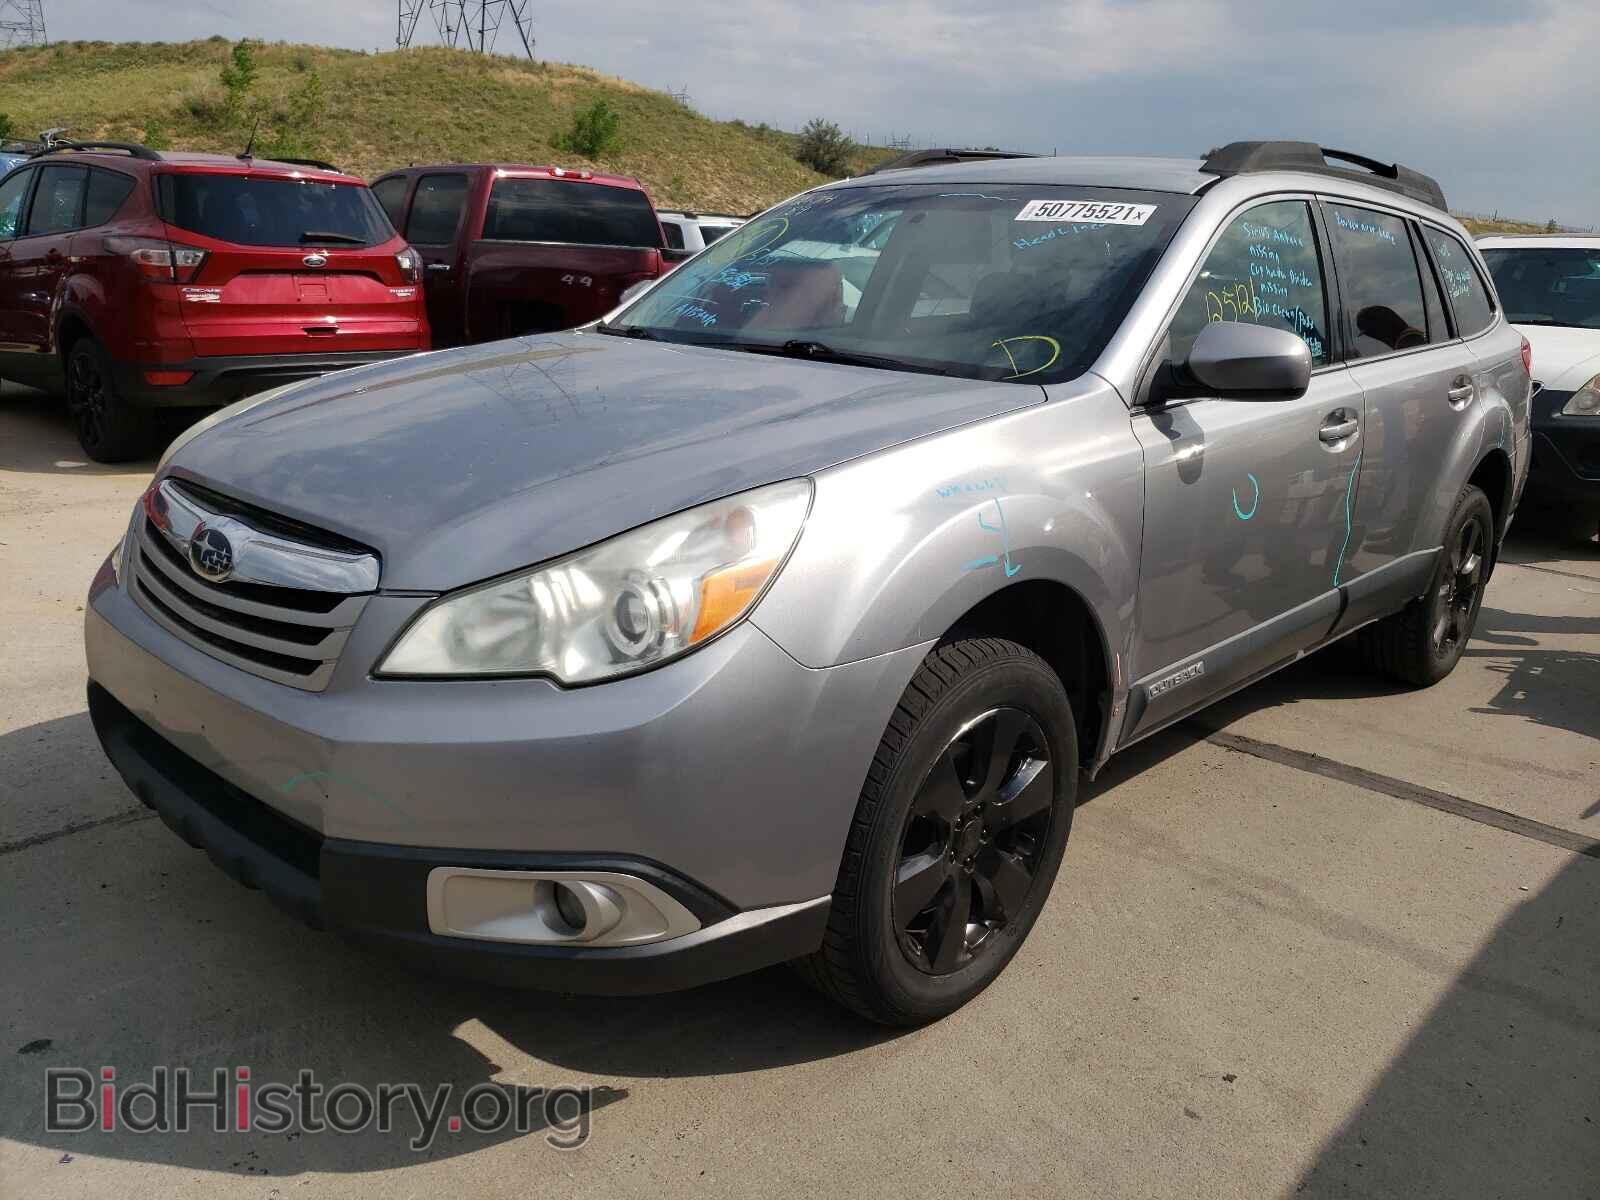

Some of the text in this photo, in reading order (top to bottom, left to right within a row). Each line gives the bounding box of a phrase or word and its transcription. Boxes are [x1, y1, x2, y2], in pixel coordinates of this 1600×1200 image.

[1035, 202, 1135, 221] 50775521
[561, 273, 593, 288] 44
[1148, 661, 1204, 698] OUTBACK
